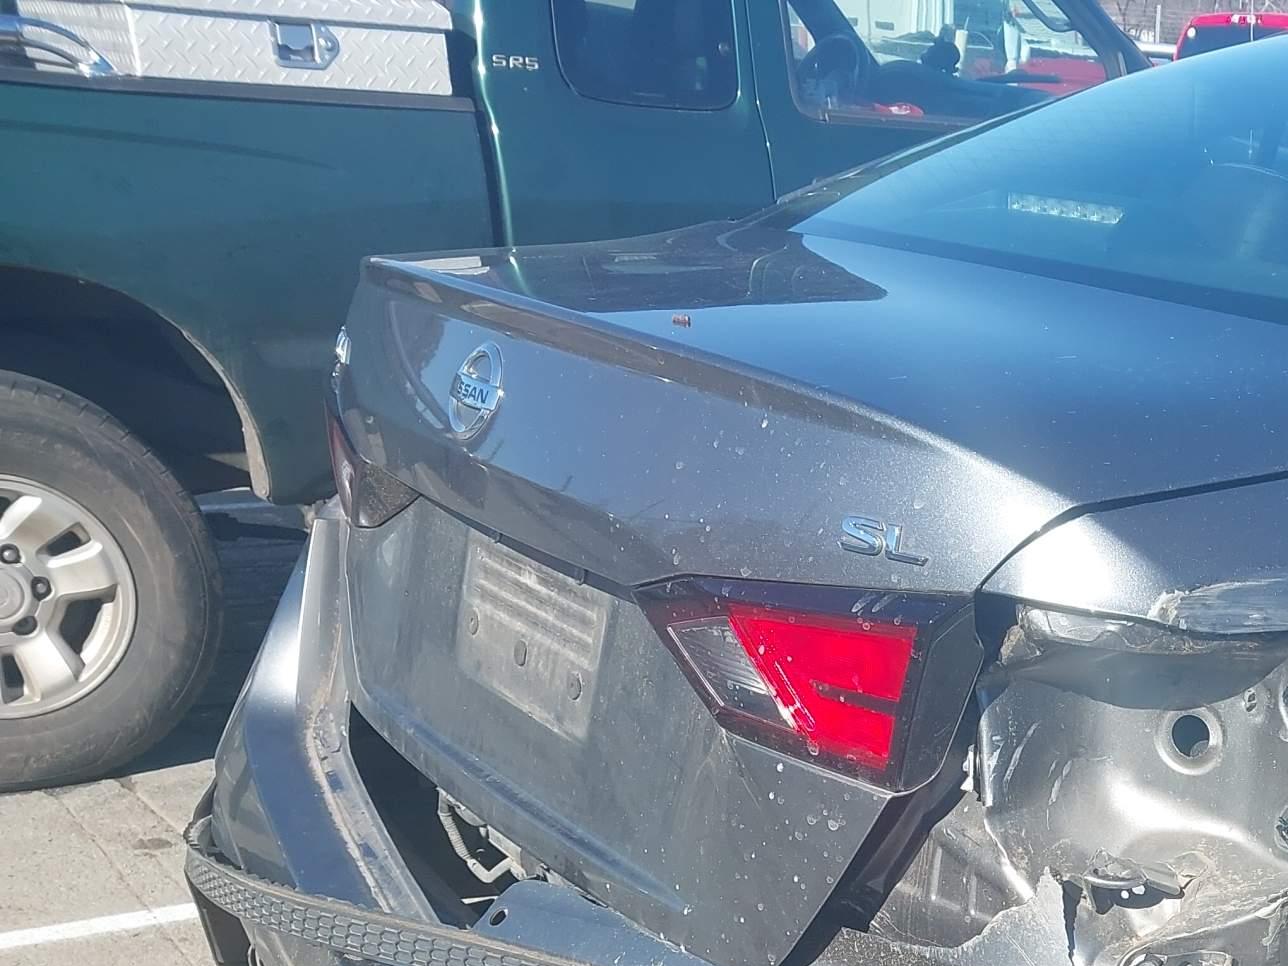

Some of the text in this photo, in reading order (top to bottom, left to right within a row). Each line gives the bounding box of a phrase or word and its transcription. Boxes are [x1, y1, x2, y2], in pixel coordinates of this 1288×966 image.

[492, 54, 539, 70] SR5
[455, 379, 490, 404] SSAN
[837, 515, 929, 567] SL
